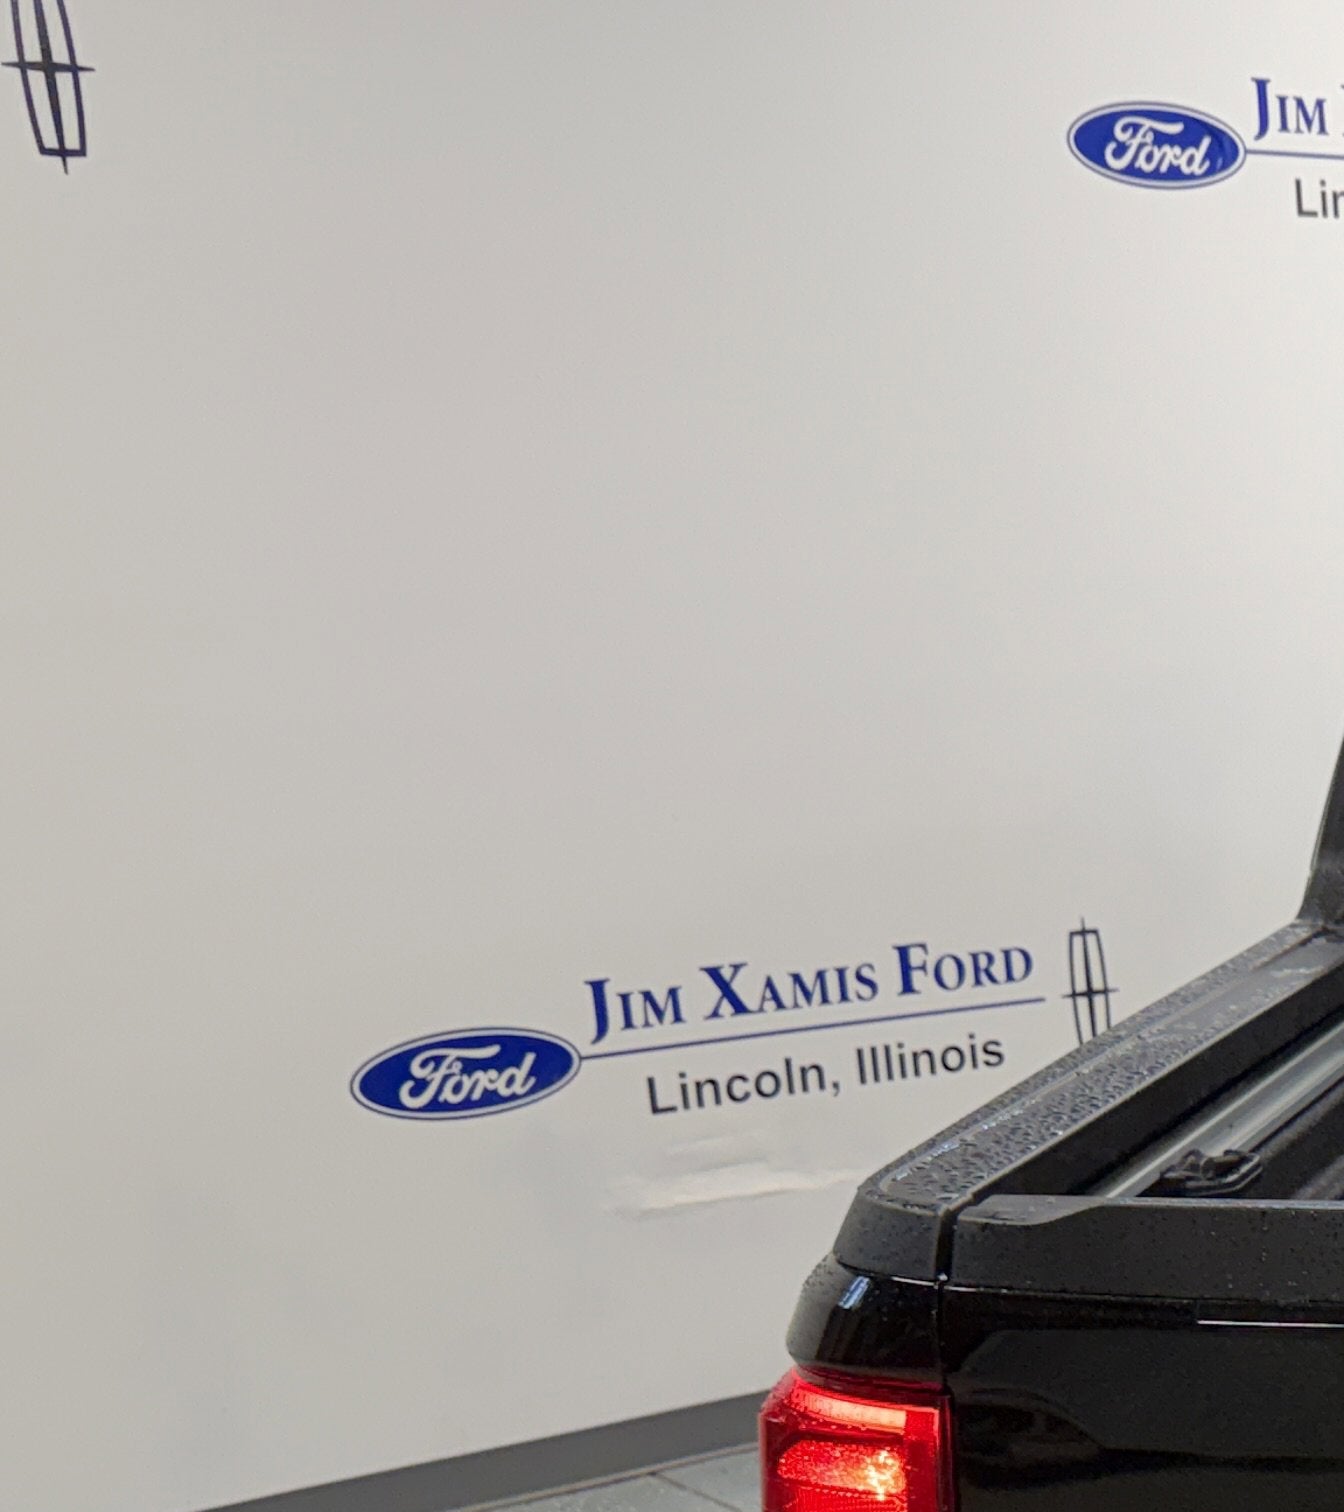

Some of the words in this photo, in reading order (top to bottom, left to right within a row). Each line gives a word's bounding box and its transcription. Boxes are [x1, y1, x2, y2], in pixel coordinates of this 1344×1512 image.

[1252, 78, 1327, 140] JIM
[1103, 114, 1212, 177] Ford
[585, 980, 683, 1044] JIM
[700, 964, 877, 1019] XAMIS
[894, 944, 1032, 995] FORD
[399, 1044, 538, 1110] Ford
[648, 1058, 839, 1114] Lincoln,
[857, 1035, 1003, 1084] Illinois
